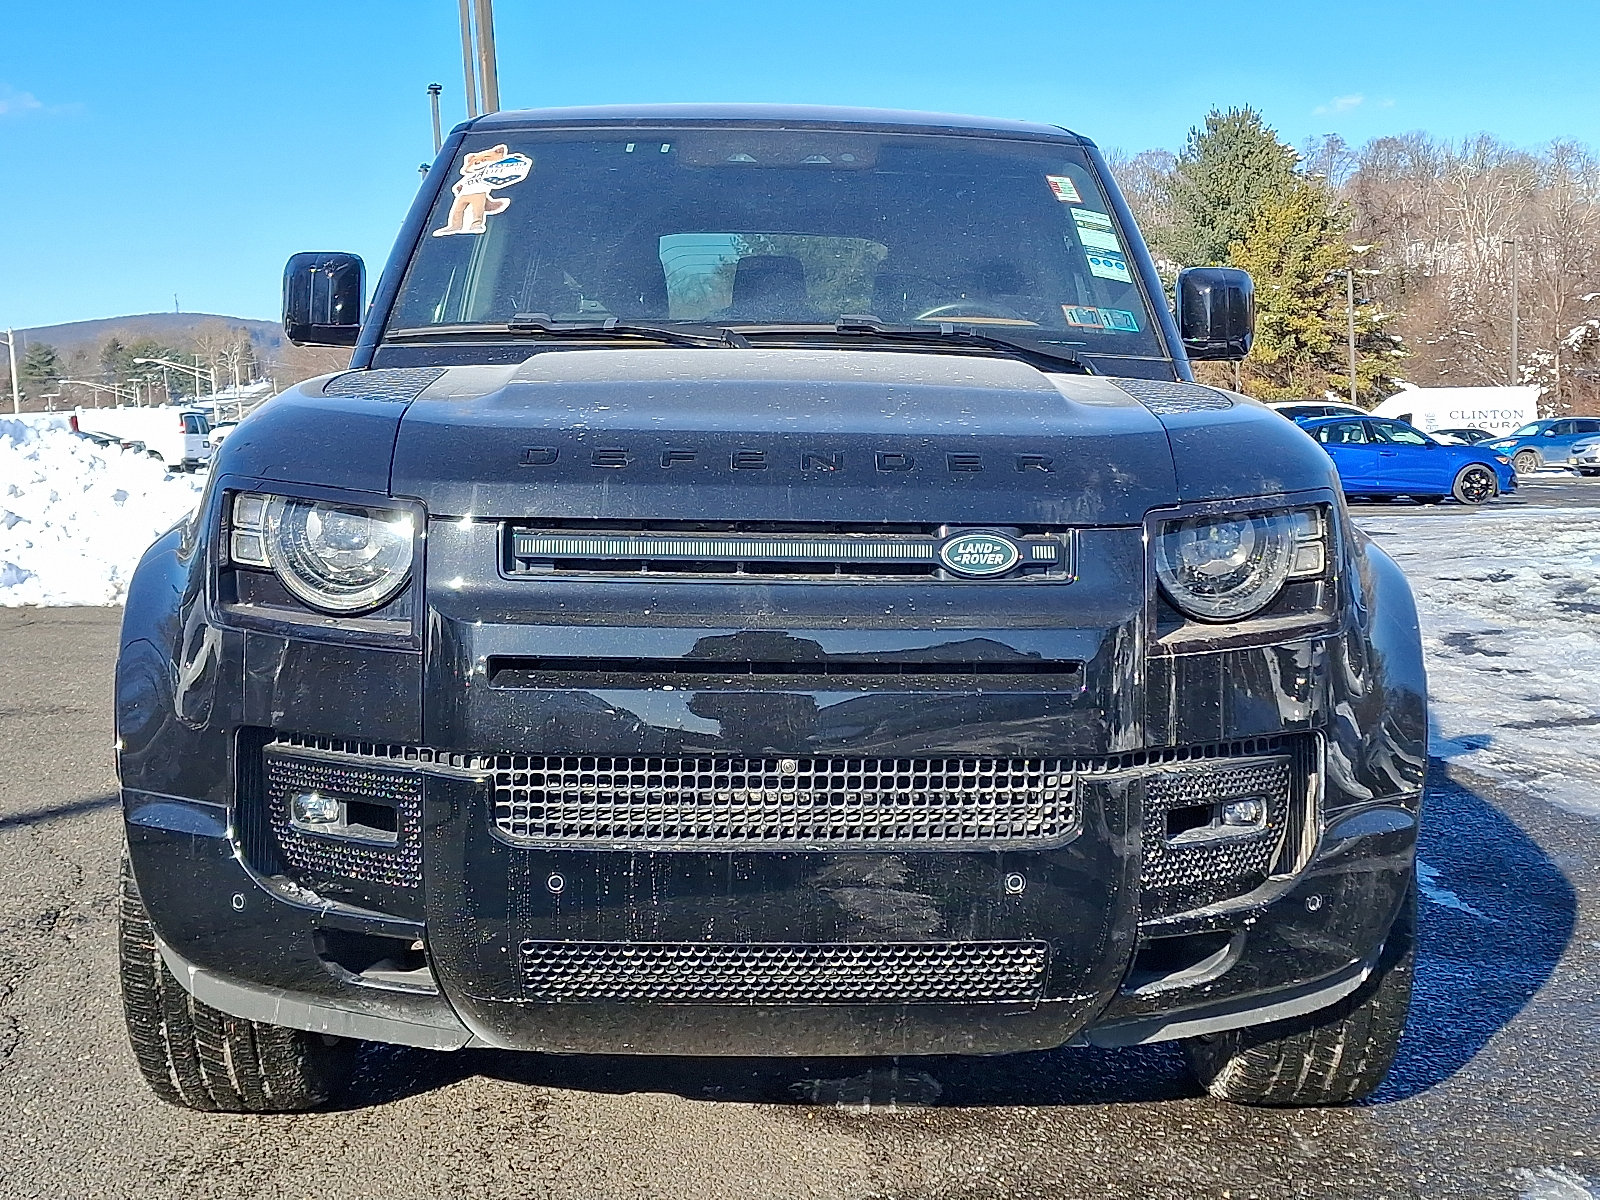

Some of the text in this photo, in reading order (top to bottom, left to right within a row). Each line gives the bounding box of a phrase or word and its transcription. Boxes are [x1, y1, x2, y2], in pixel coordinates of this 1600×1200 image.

[1449, 409, 1524, 420] CLINTON
[1467, 421, 1522, 429] ACURA
[518, 446, 1055, 474] DEFENDER
[957, 543, 993, 554] LAND
[960, 553, 1005, 565] ROVER
